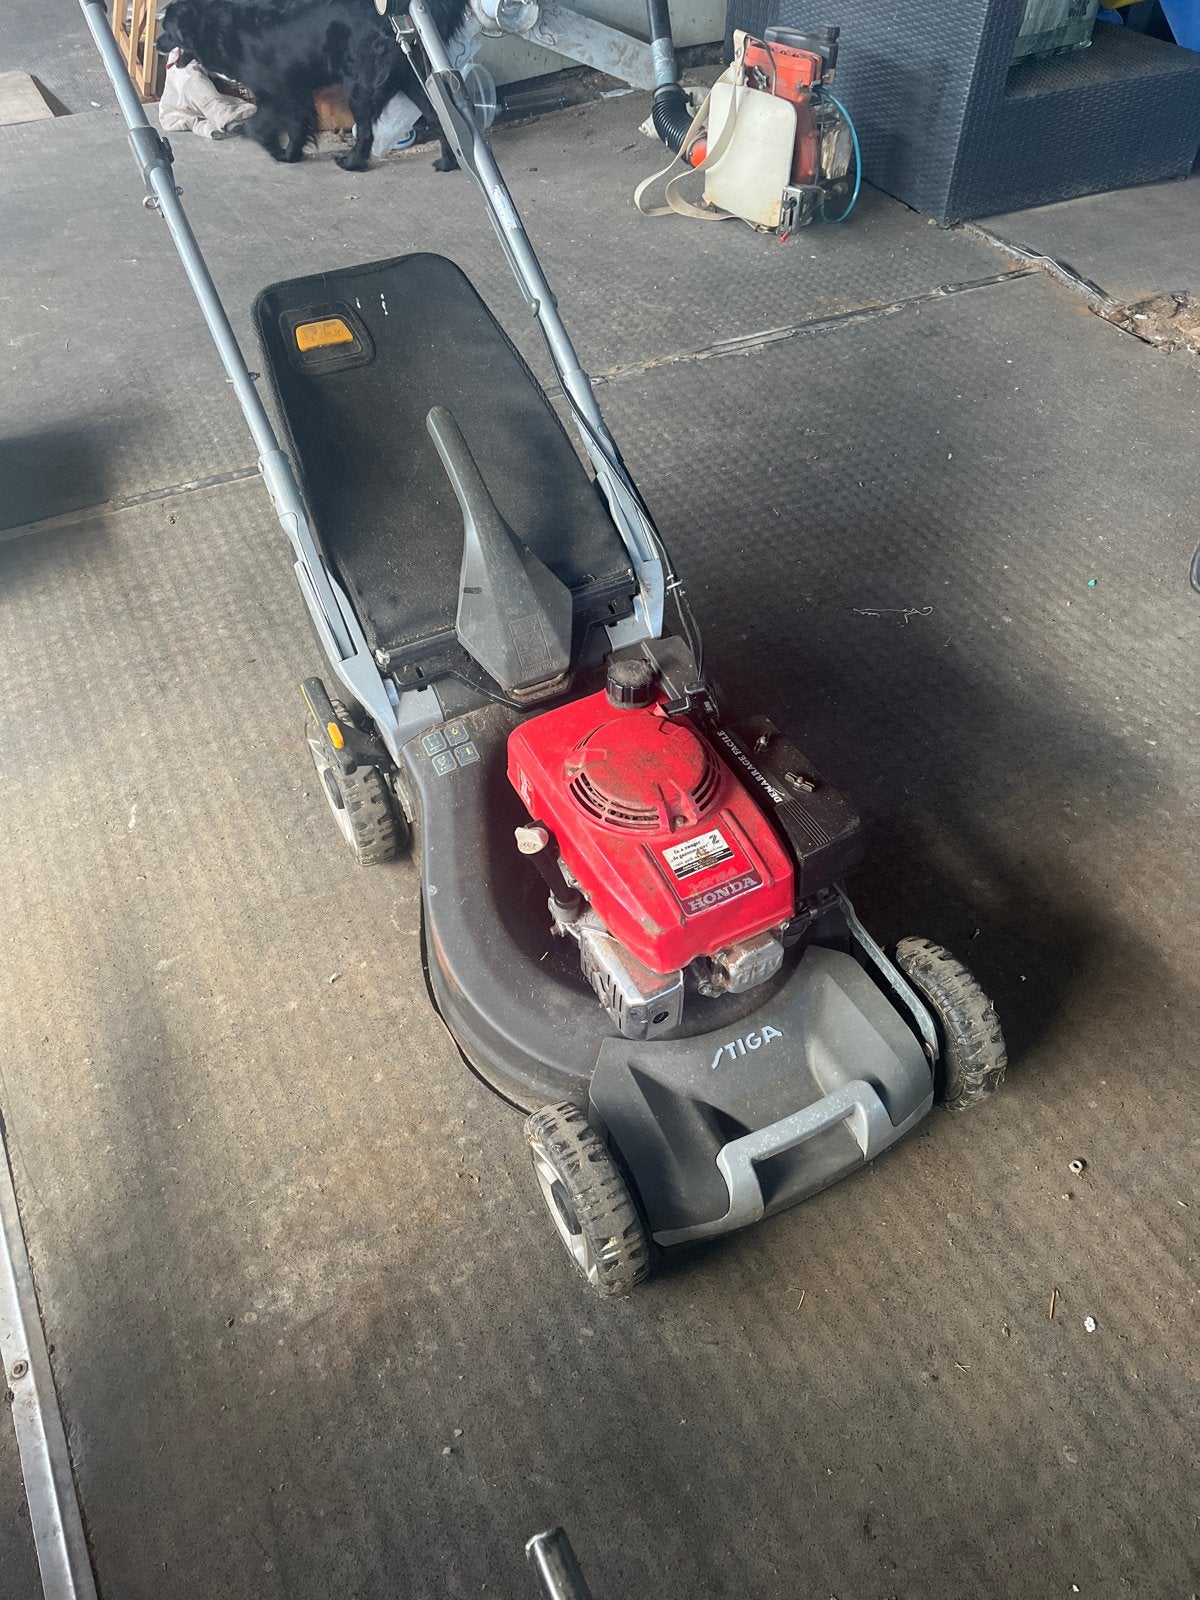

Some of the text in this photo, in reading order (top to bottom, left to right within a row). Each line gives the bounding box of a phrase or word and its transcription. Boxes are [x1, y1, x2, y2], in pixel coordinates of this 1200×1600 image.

[716, 730, 783, 803] DEMARRAGE FACILE
[688, 877, 757, 911] HONDA
[711, 1025, 783, 1069] STIGA
